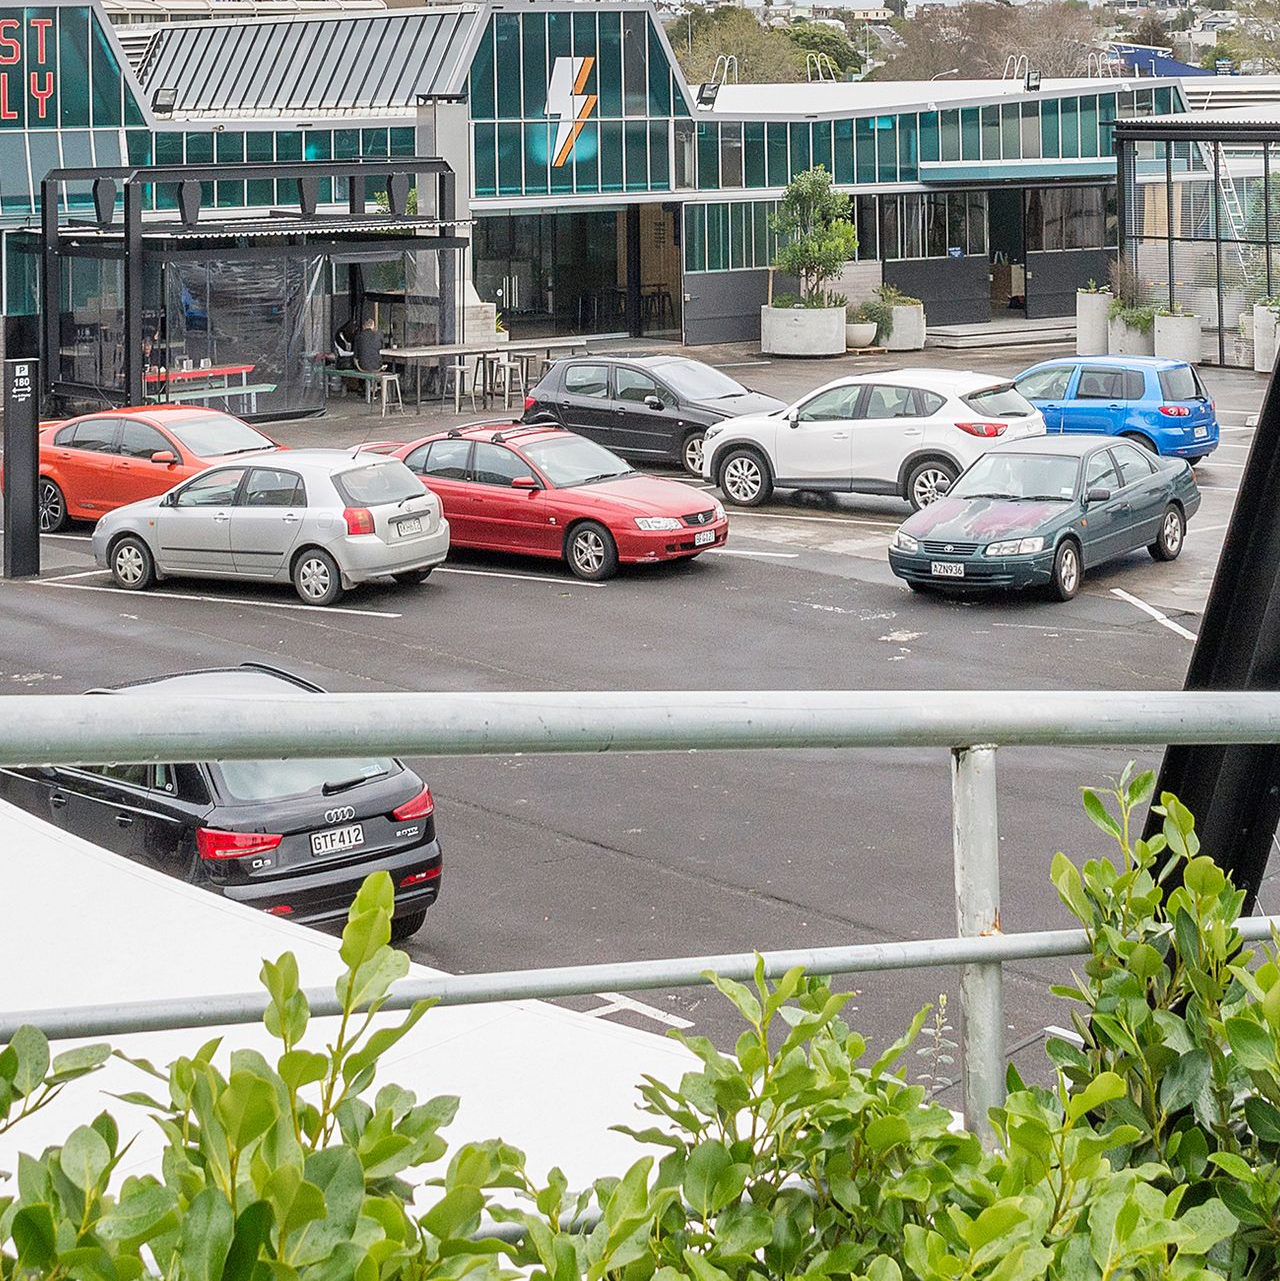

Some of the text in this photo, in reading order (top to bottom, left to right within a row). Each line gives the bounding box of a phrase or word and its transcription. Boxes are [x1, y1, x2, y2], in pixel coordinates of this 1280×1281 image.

[13, 377, 30, 387] 180
[932, 563, 963, 575] AZN936
[313, 827, 362, 851] GTF412
